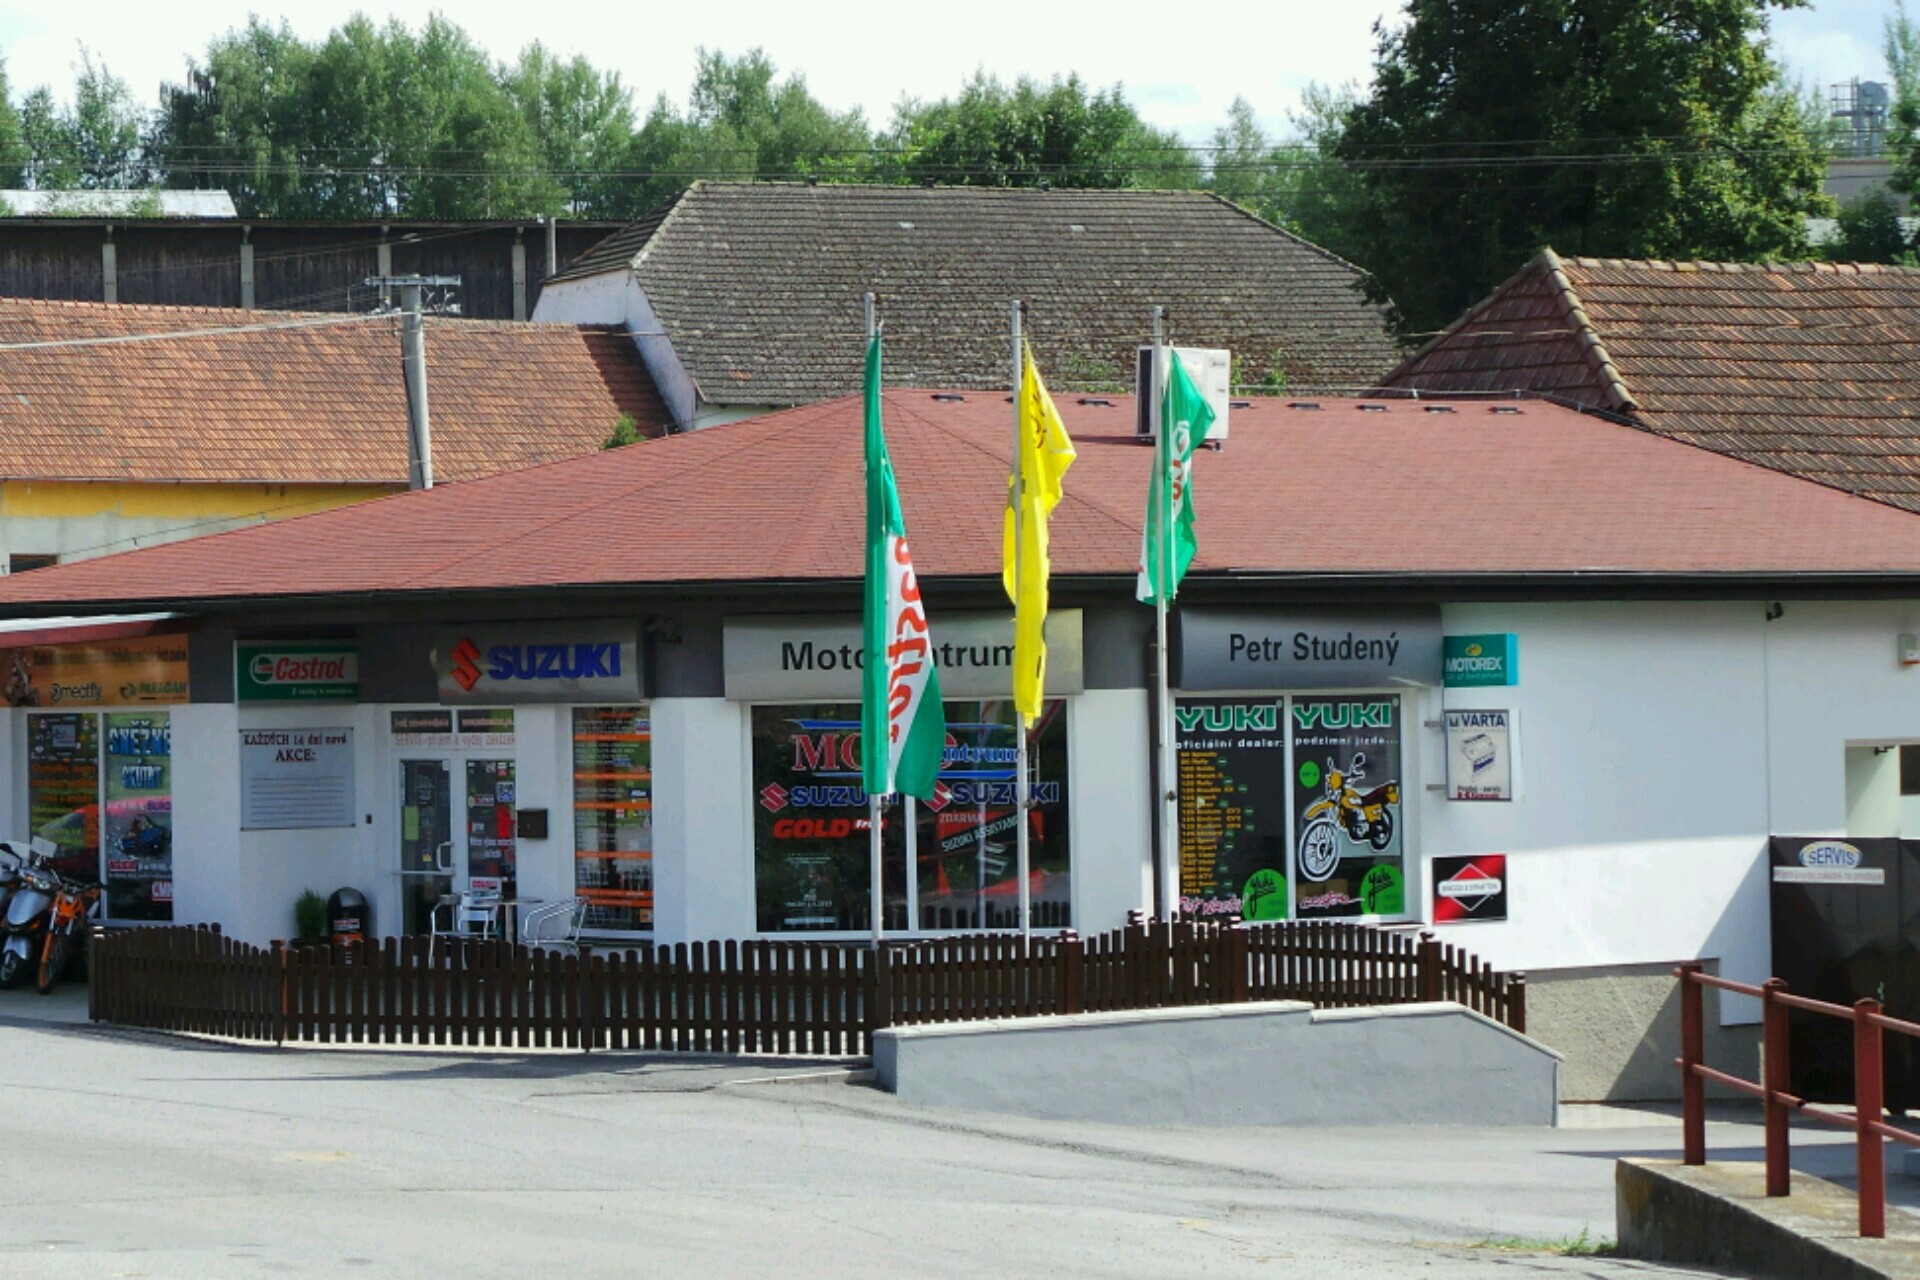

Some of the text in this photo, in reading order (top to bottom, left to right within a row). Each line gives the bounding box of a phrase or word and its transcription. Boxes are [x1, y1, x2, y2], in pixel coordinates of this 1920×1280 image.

[1229, 631, 1400, 666] Petr Studený
[275, 656, 346, 681] Castrol
[489, 644, 621, 680] SUZUKI
[1445, 657, 1503, 672] MOTOREX
[1175, 704, 1278, 732] YUKI
[1292, 702, 1393, 730] YUKI
[1461, 714, 1506, 727] VARTA
[1176, 738, 1232, 749] oficiální
[276, 748, 317, 762] AKCE:
[790, 785, 900, 807] SUZUI
[773, 818, 851, 839] GOLD
